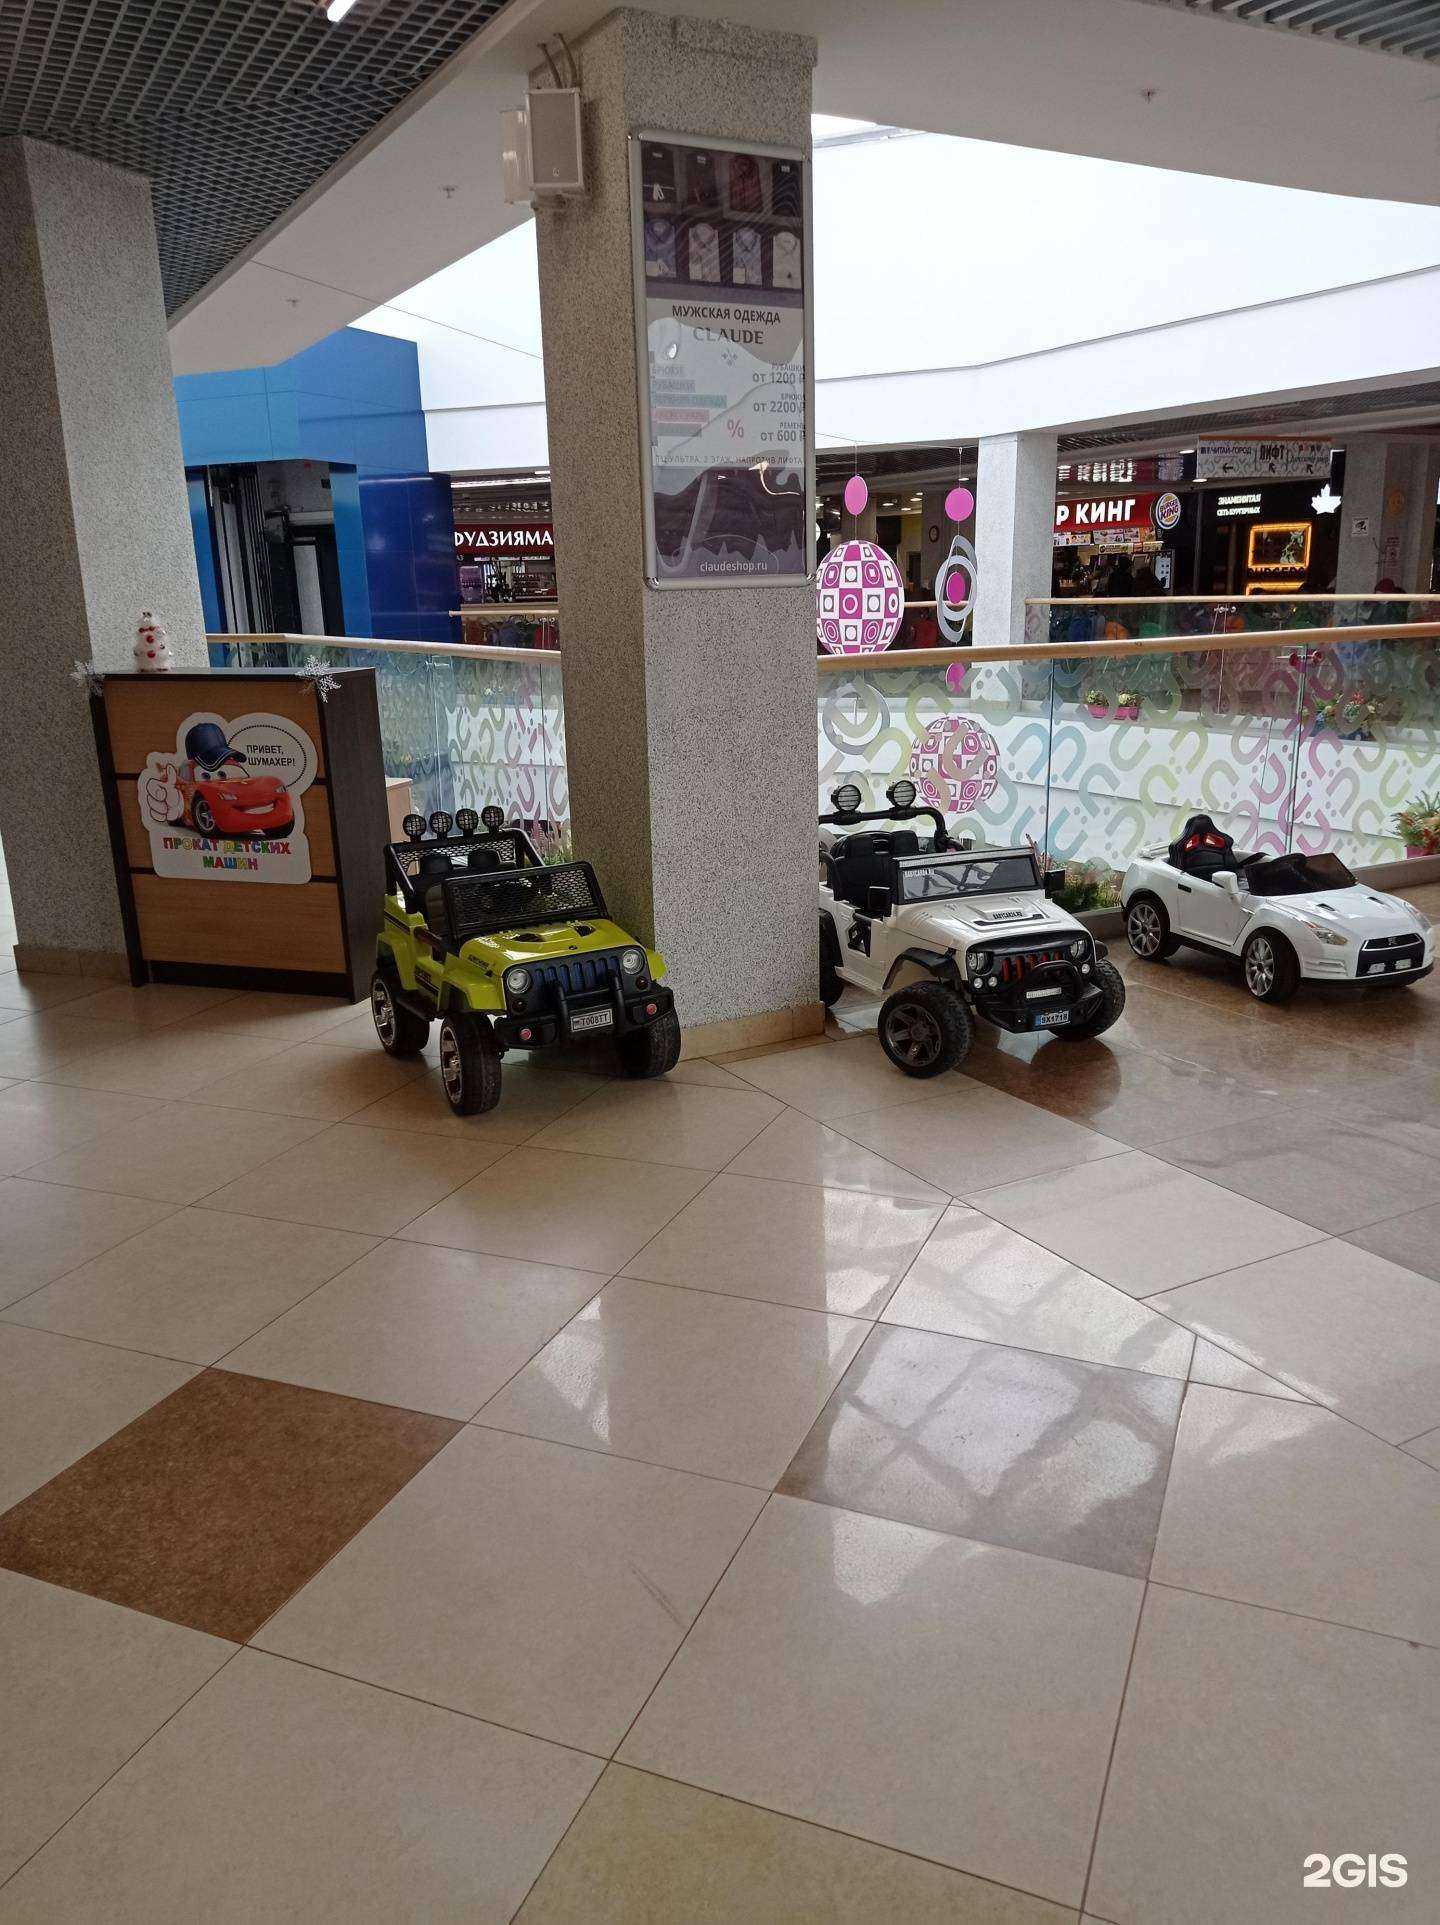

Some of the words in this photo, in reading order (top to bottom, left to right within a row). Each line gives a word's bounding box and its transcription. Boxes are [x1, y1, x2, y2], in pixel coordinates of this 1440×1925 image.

[672, 304, 730, 320] МУЖСКАЯ
[733, 308, 781, 325] ОДЕЖДА
[693, 326, 764, 345] CLAUDE
[770, 371, 796, 385] 1200
[770, 401, 797, 414] 2200
[776, 429, 797, 442] 600
[1075, 499, 1136, 524] КИНГ
[700, 561, 768, 572] claudeshop.ru
[246, 744, 284, 755] ПРИВЕТ,
[248, 756, 296, 767] ШУМАХЕР!
[163, 837, 220, 852] ПРОКАТ
[223, 840, 292, 856] ДЕТСКИХ
[202, 856, 259, 871] МАШИН
